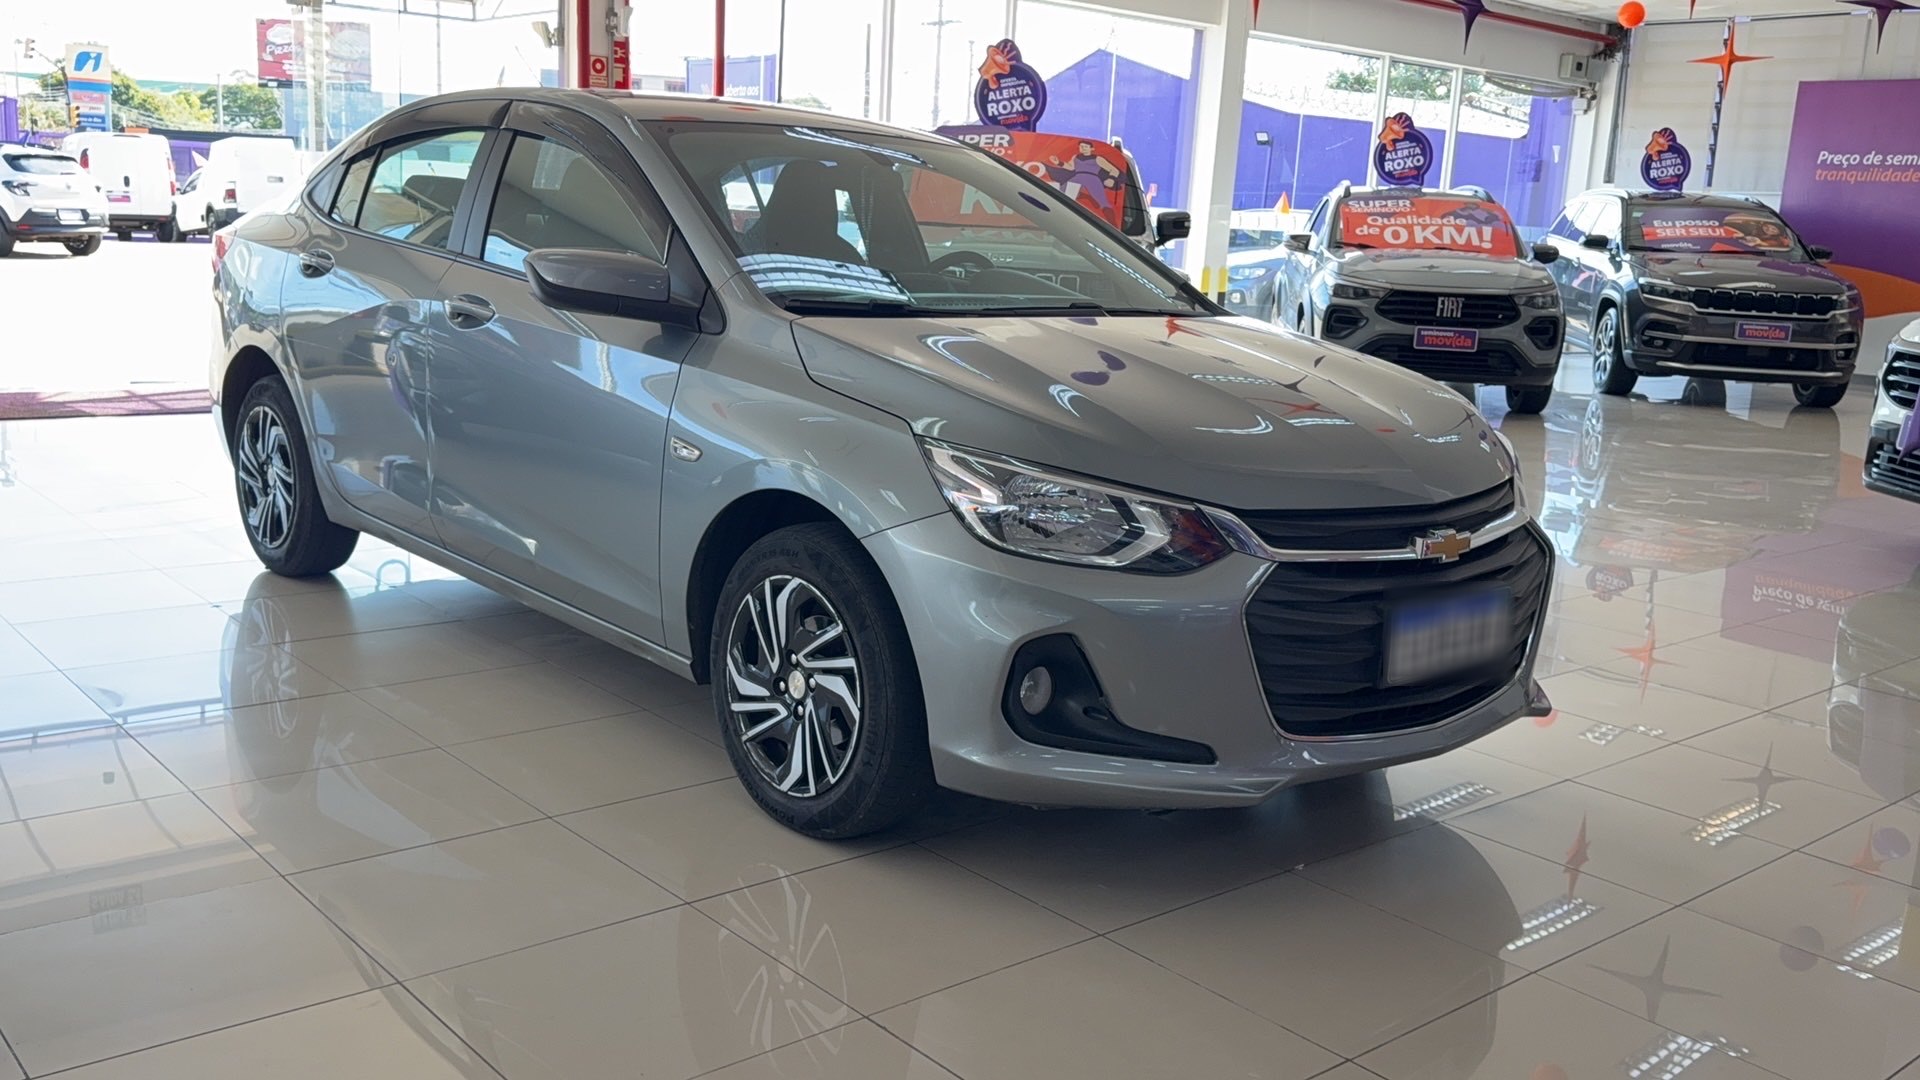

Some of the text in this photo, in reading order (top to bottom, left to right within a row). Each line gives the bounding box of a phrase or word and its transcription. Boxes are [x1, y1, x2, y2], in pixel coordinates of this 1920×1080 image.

[988, 86, 1032, 101] ALERTA
[987, 97, 1035, 117] ROXO
[958, 134, 1010, 147] PER
[1385, 147, 1421, 160] ALERTA
[1817, 151, 1860, 168] Preço
[1863, 151, 1883, 165] de
[1384, 155, 1424, 172] ROXO
[1651, 158, 1681, 168] ALERTA
[1650, 165, 1684, 179] ROXO
[1815, 168, 1920, 184] tranquilidade
[1348, 200, 1411, 208] SUPER
[1367, 216, 1467, 226] Qualidade
[1675, 220, 1719, 228] posso
[1355, 226, 1380, 235] de
[1656, 228, 1726, 237] SER SEU!
[1436, 297, 1465, 317] FIAT
